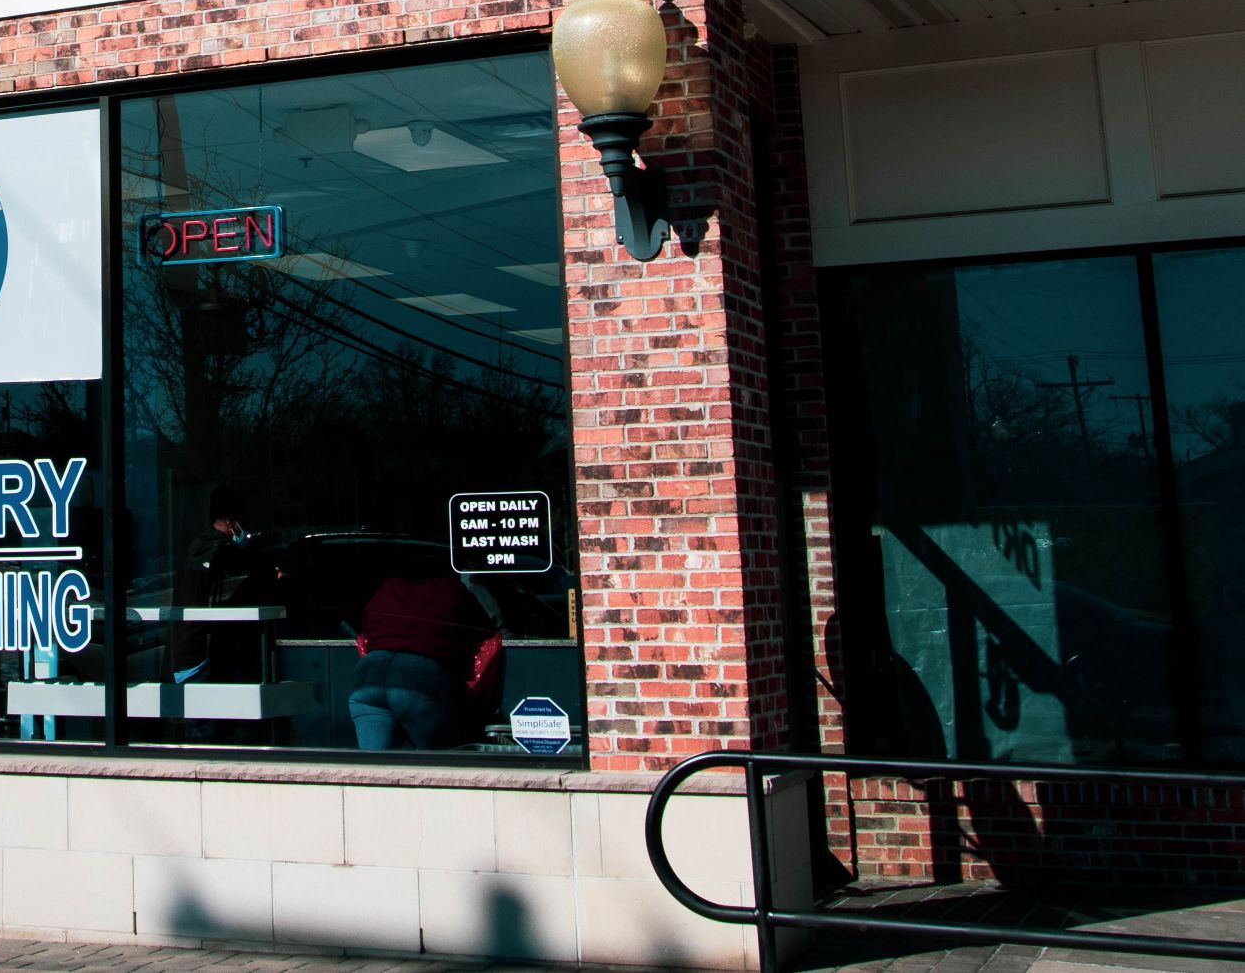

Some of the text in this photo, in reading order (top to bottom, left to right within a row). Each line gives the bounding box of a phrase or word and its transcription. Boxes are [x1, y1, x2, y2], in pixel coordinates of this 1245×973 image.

[145, 214, 273, 258] OPEN
[459, 499, 539, 512] OPEN DAILY
[460, 518, 489, 530] 6AM
[500, 518, 515, 529] 10
[519, 517, 539, 528] PM
[462, 535, 539, 547] LAST WASH
[486, 553, 515, 565] 9PM
